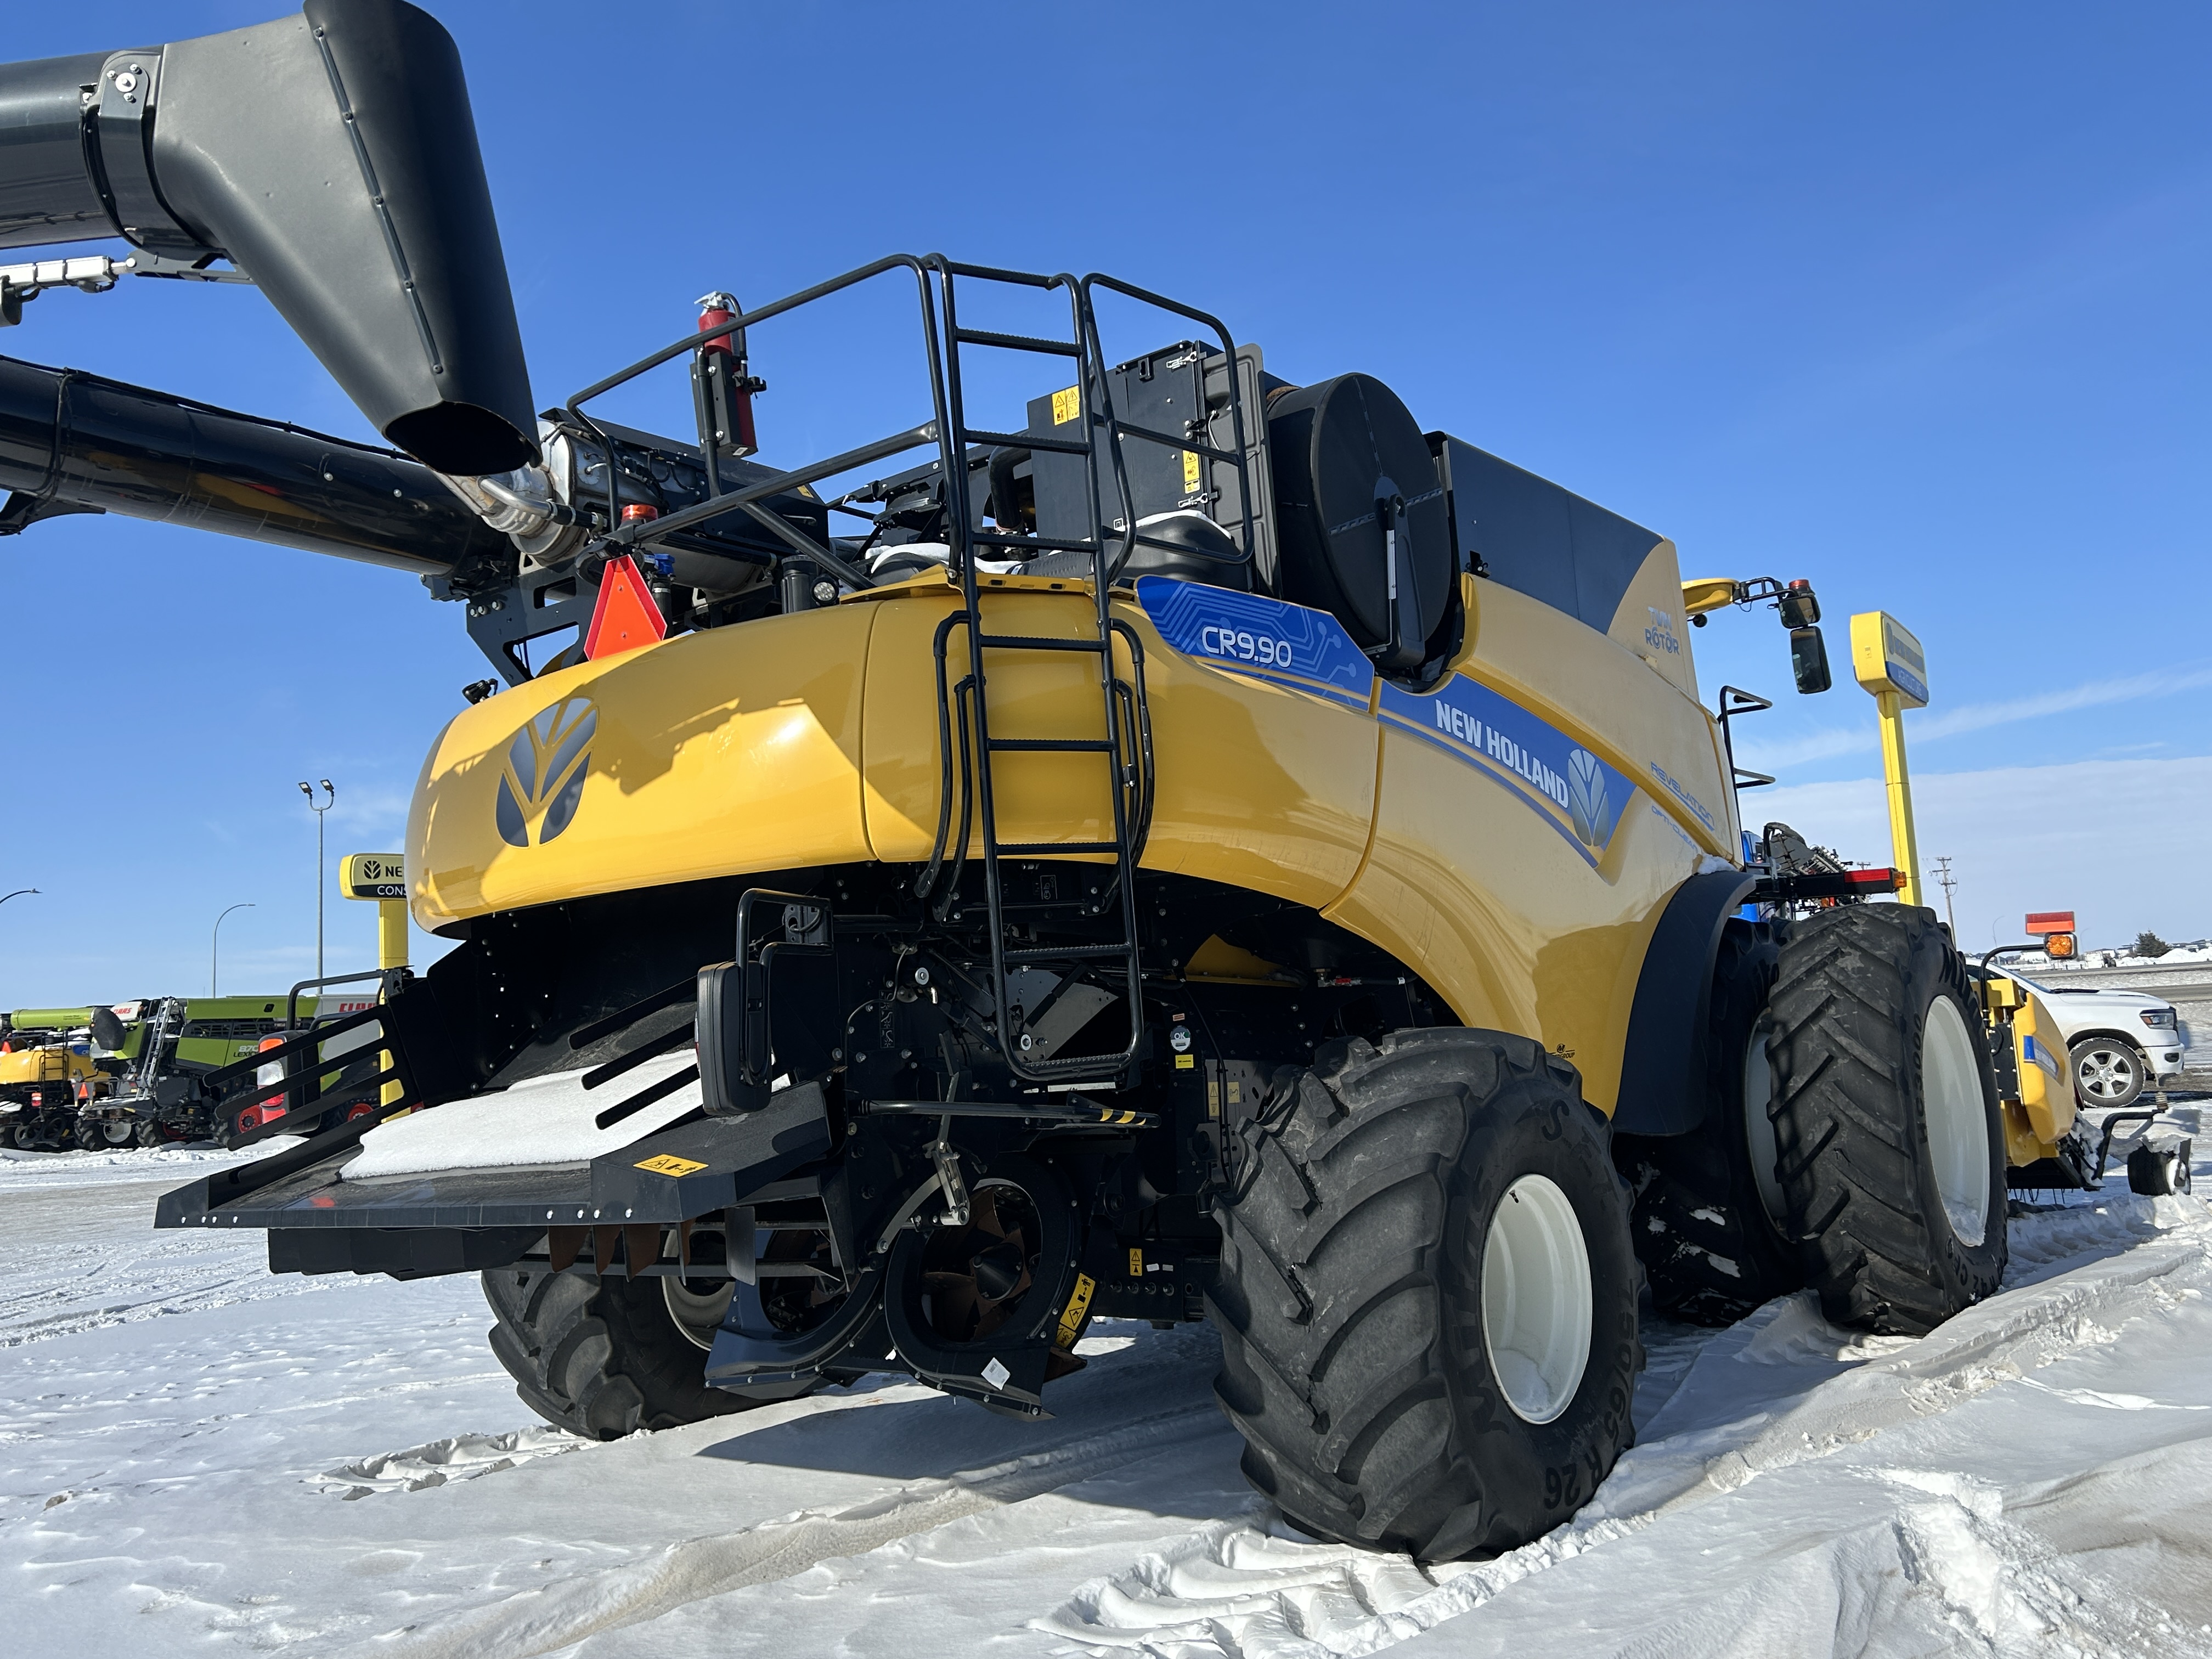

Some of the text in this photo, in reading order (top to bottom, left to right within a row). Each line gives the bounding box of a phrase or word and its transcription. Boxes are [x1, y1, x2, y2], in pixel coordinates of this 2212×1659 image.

[1647, 606, 1672, 630] TWIN
[1202, 627, 1292, 668] CR9.90
[1645, 626, 1680, 655] ROTOR
[1435, 699, 1568, 808] NEW HOLLAND
[1651, 760, 1715, 827] REVELATION
[385, 866, 404, 877] NE
[1174, 1031, 1186, 1040] OK
[1603, 1278, 1634, 1450] 750/65
[1544, 1462, 1581, 1509] 26
